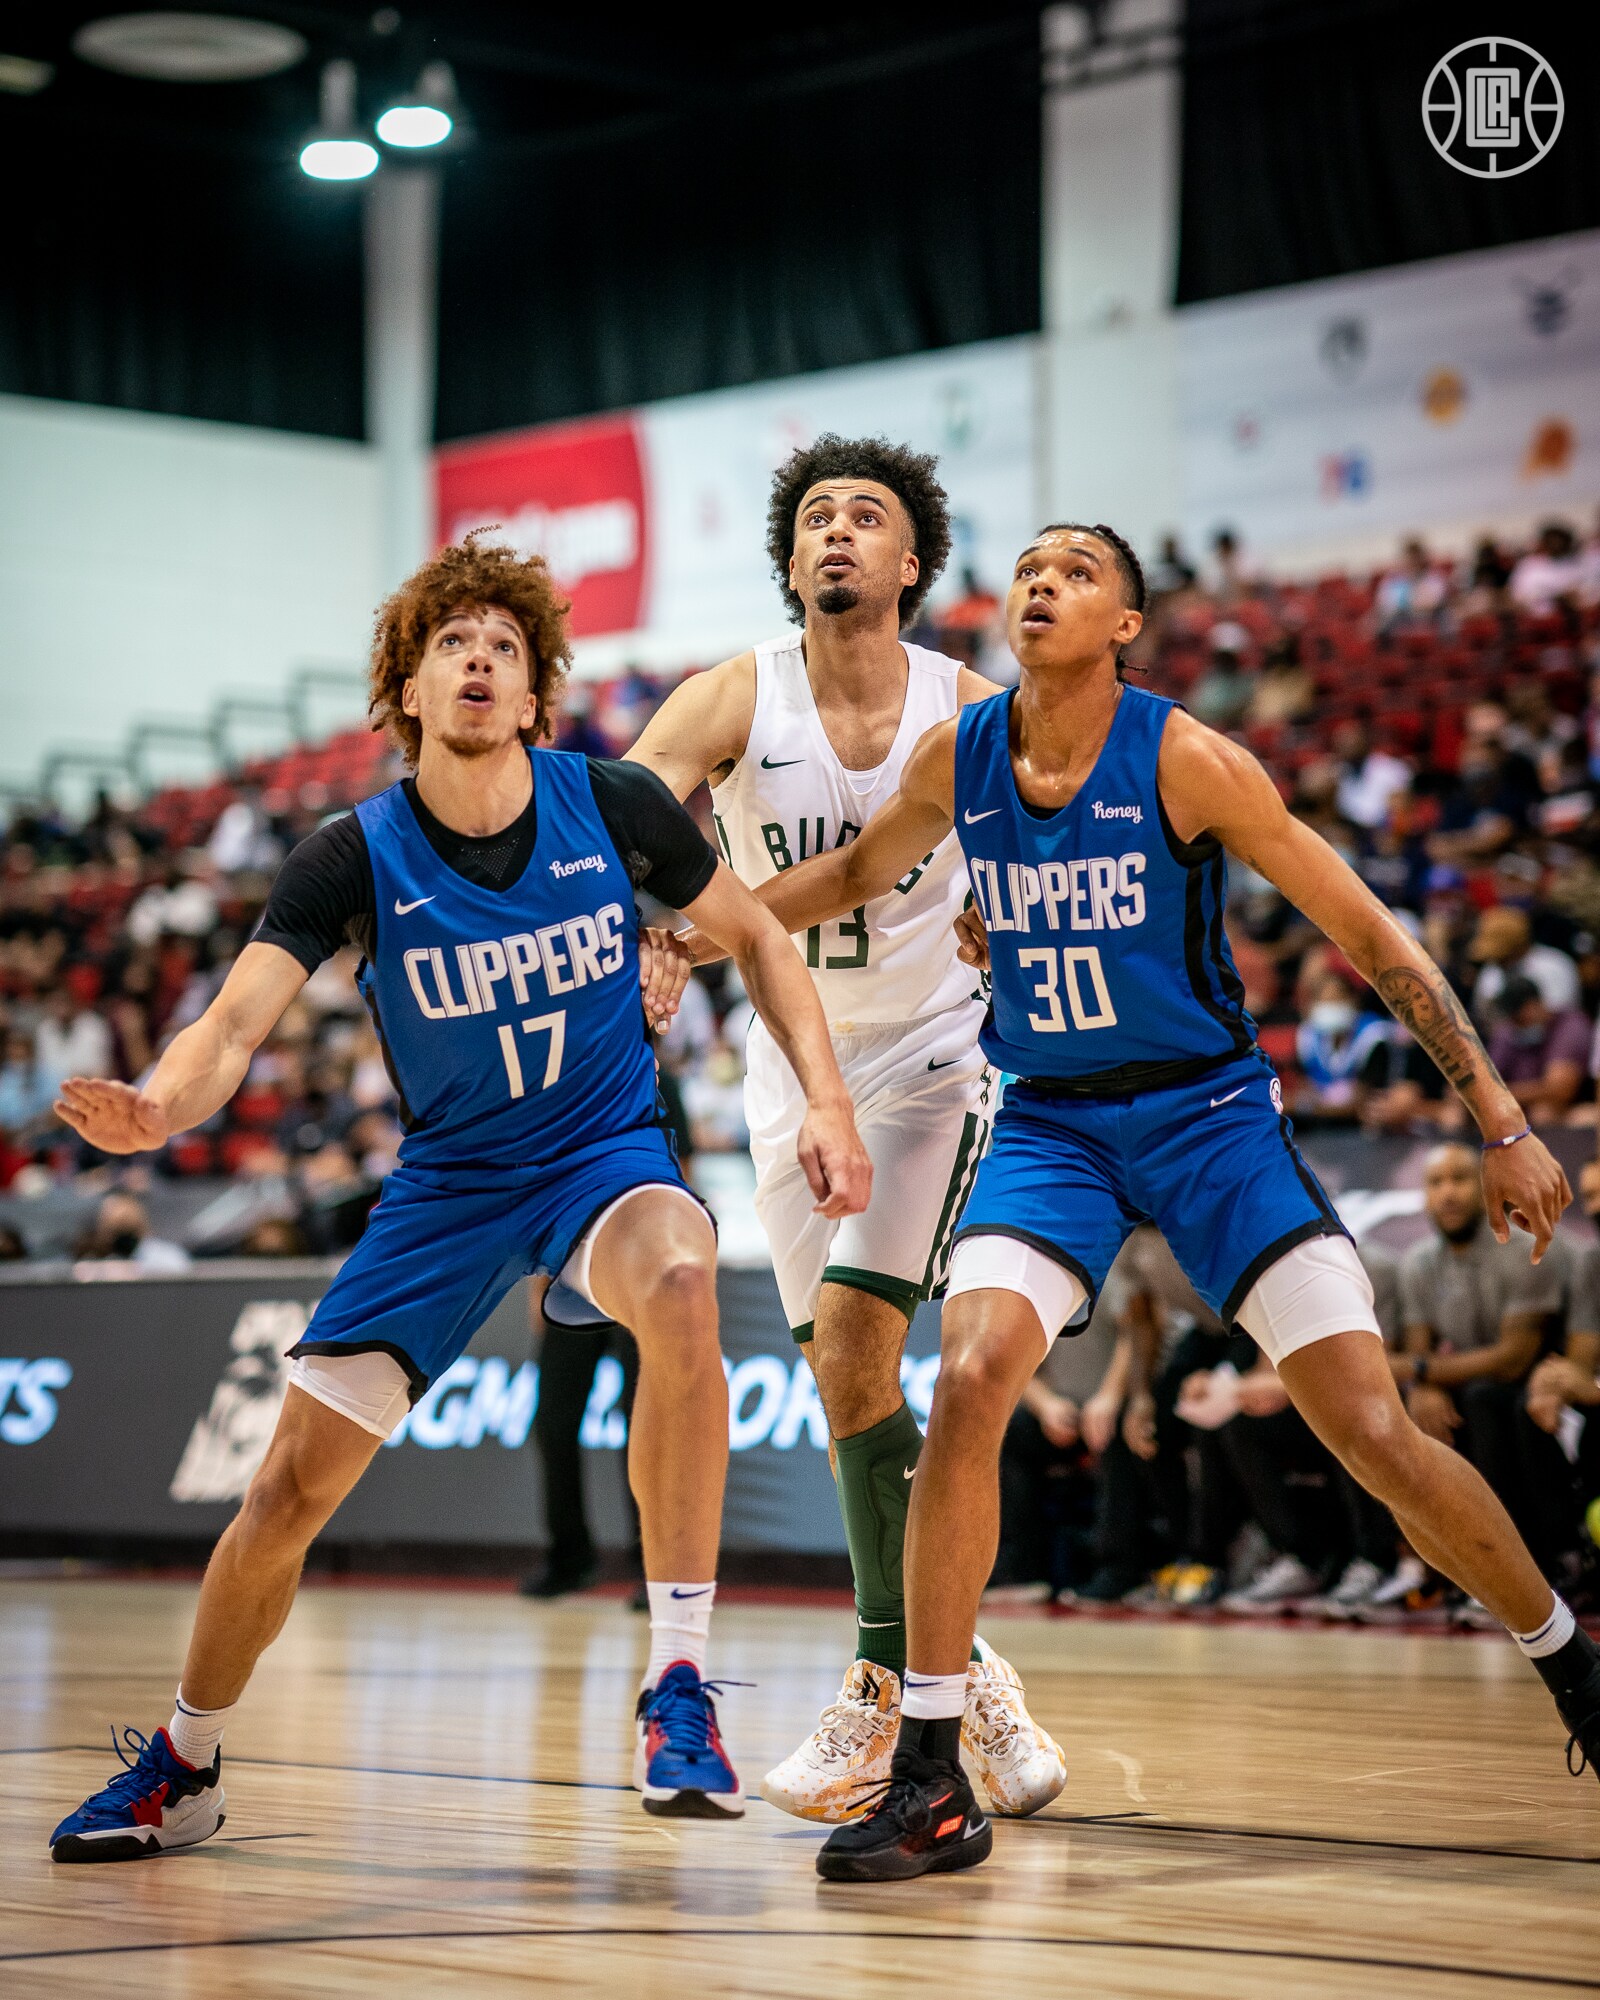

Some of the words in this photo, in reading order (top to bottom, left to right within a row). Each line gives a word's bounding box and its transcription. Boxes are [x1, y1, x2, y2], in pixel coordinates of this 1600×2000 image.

[1092, 801, 1144, 824] honey
[549, 853, 608, 880] honey
[970, 852, 1147, 933] CLIPPERS
[403, 902, 625, 1020] CLIPPERS
[806, 903, 869, 970] 13
[1017, 946, 1118, 1033] 30
[497, 1009, 567, 1100] 17
